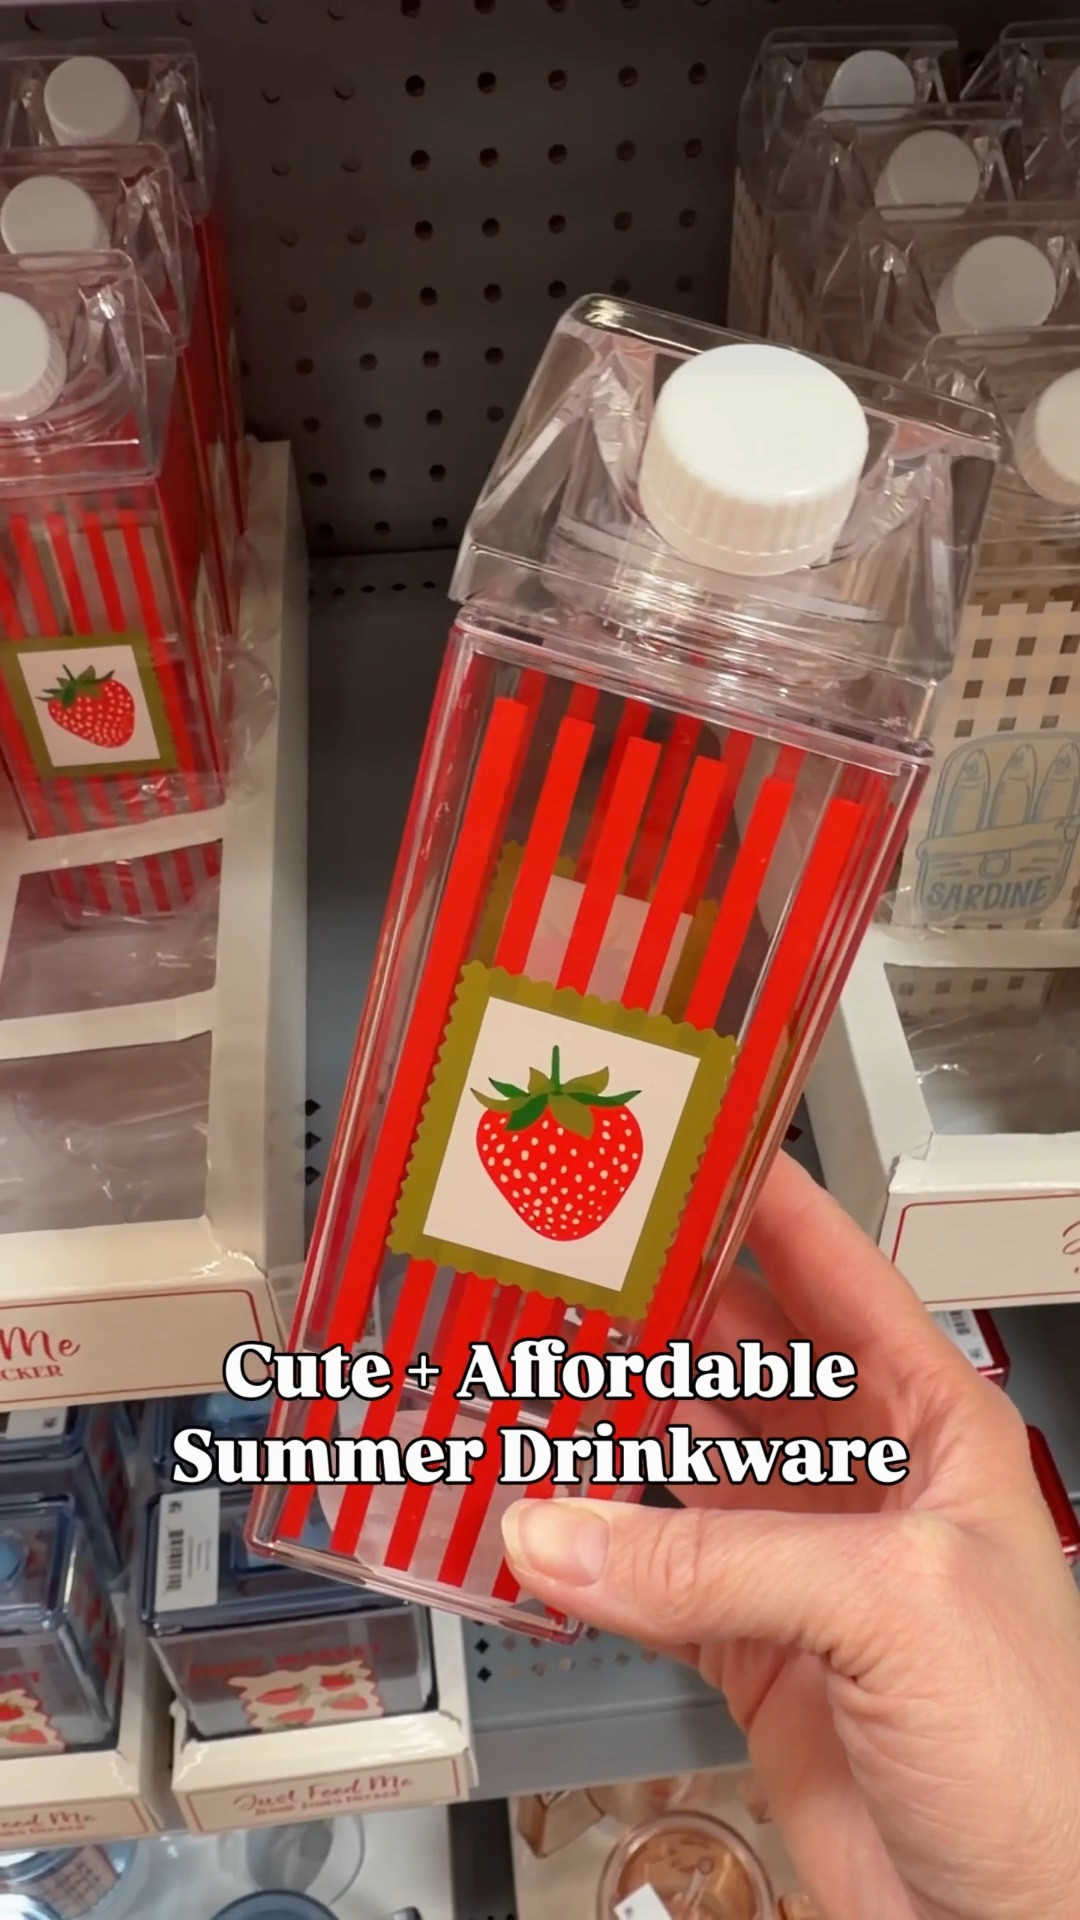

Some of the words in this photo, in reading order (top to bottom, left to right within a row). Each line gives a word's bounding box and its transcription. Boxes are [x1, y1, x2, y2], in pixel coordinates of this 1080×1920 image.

[926, 875, 1052, 911] SARDINE
[233, 1790, 295, 1812] Just
[308, 1779, 361, 1800] Feed
